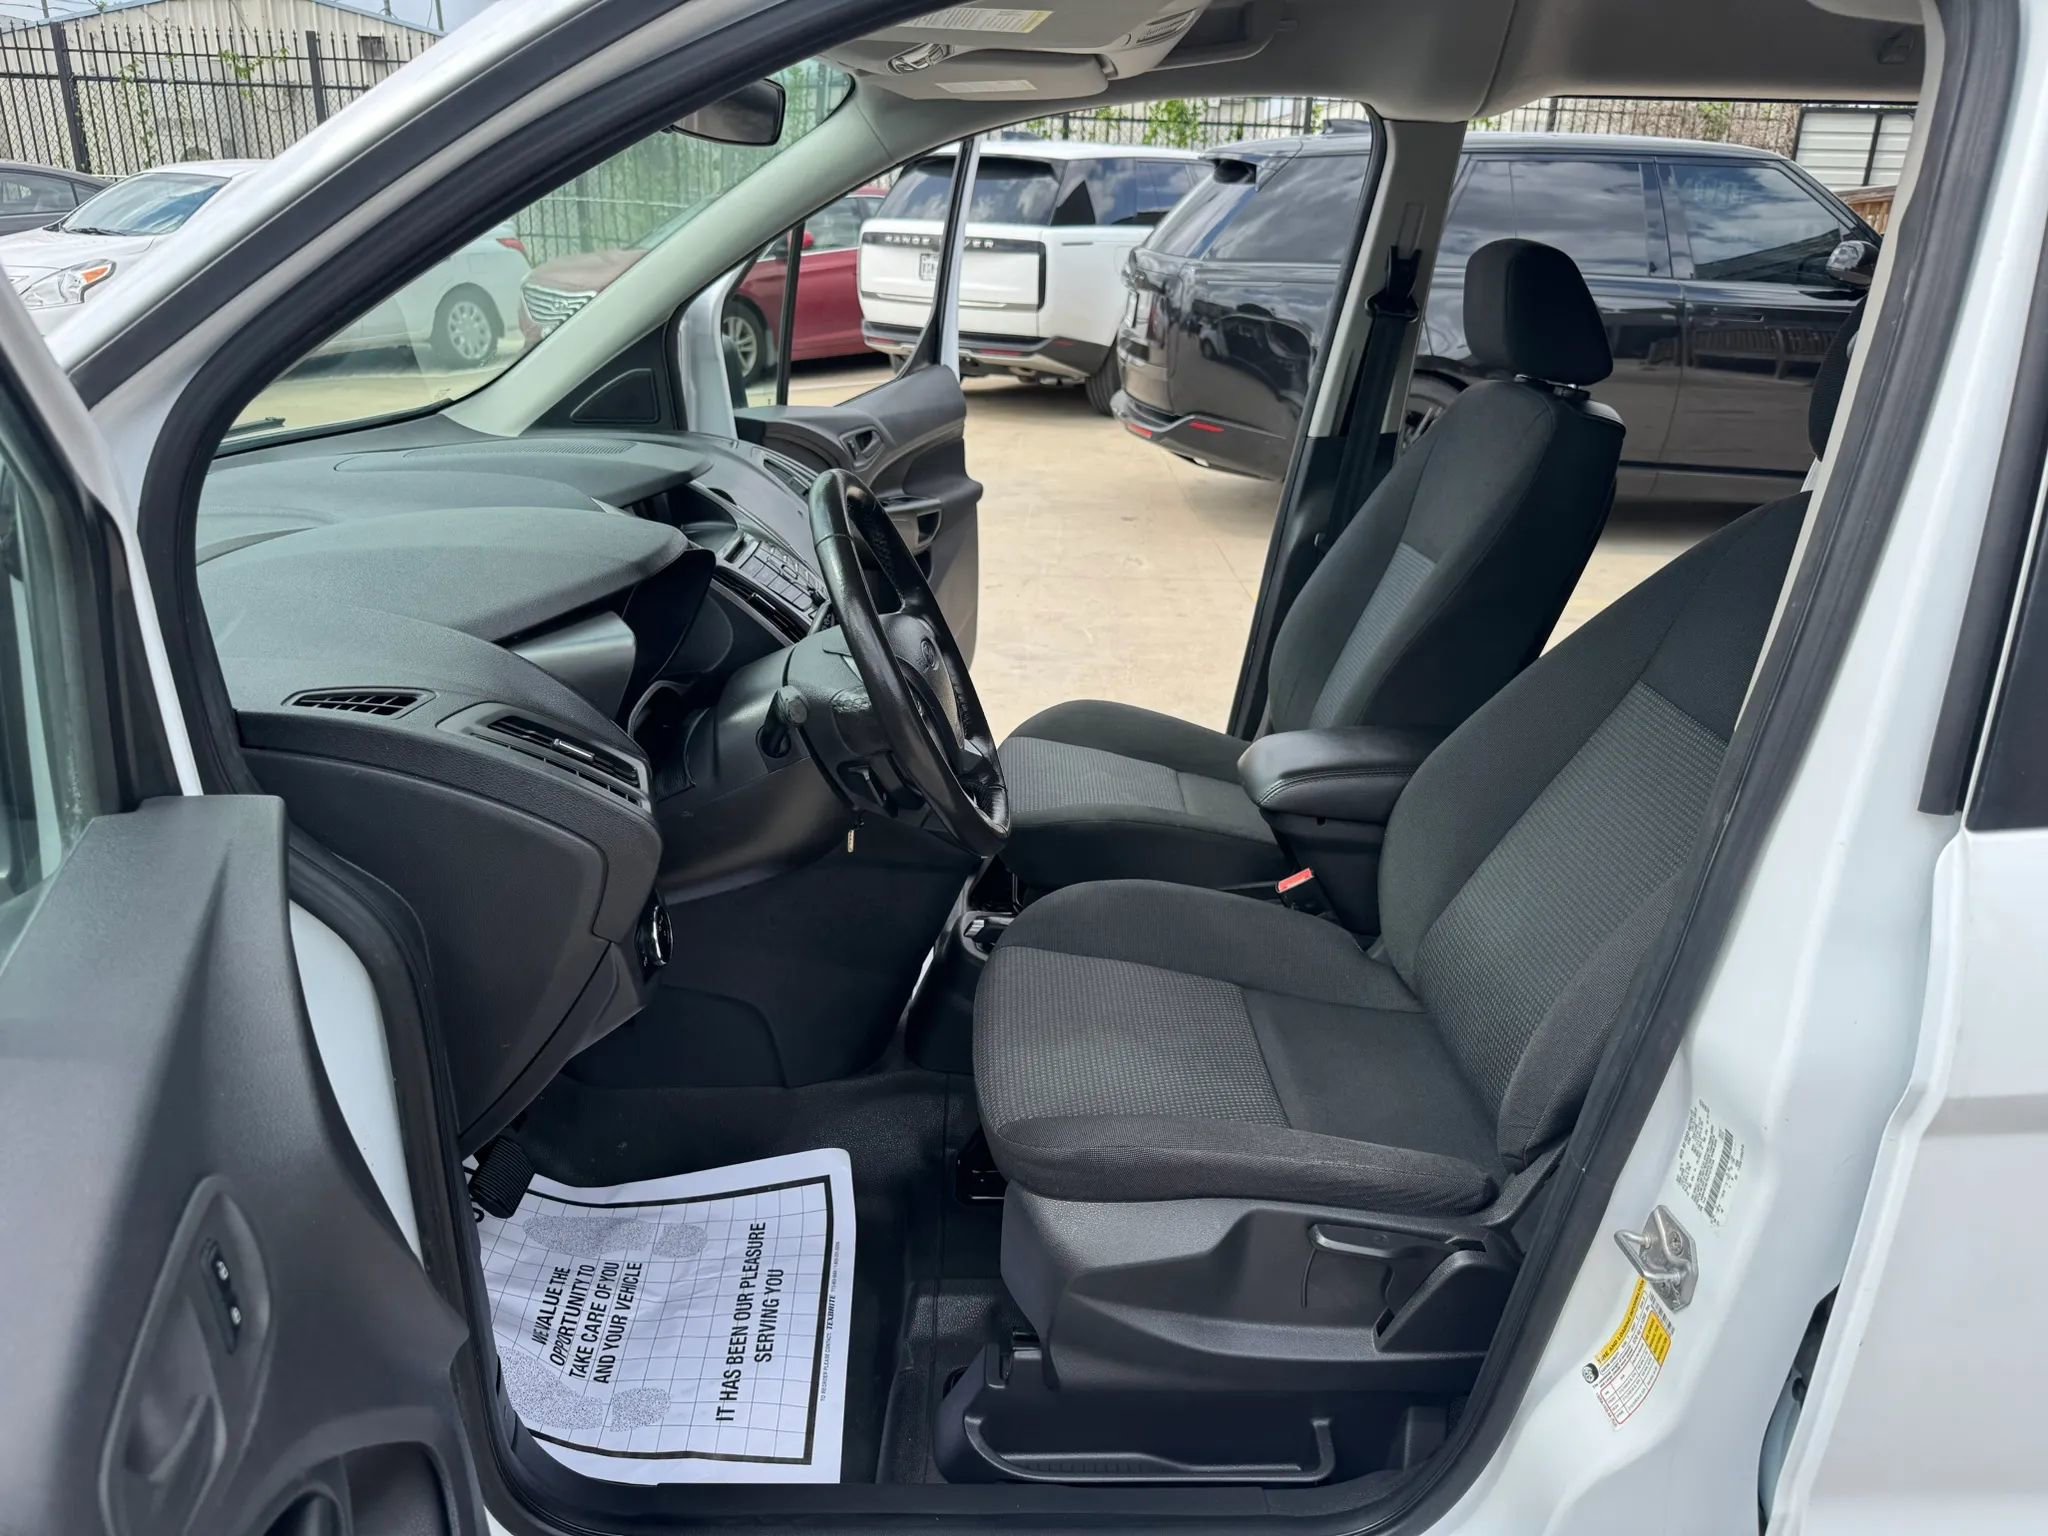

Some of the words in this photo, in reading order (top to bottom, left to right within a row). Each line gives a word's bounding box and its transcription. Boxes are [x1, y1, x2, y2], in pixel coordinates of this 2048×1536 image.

[885, 235, 930, 246] RANGE
[598, 1261, 620, 1282] YOU
[739, 1222, 766, 1289] PLEASURE
[549, 1266, 571, 1285] THE
[594, 1283, 613, 1300] OF
[614, 1262, 643, 1311] VEHICLE
[763, 1268, 785, 1295] YOU
[536, 1287, 563, 1331] VALUE
[549, 1278, 591, 1367] OPPORTUNITY
[576, 1264, 596, 1278] TO
[580, 1301, 608, 1343] CARE
[733, 1292, 755, 1322] OUR
[826, 1294, 836, 1330] TEXBRITE
[531, 1328, 549, 1346] WE
[602, 1314, 629, 1351] YOUR
[753, 1298, 781, 1363] SERVING
[1617, 1316, 1631, 1340] LOADING
[725, 1325, 749, 1365] BEEN
[568, 1345, 595, 1378] TAKE
[592, 1354, 616, 1384] AND
[718, 1369, 742, 1401] HAS
[715, 1405, 736, 1421] IT
